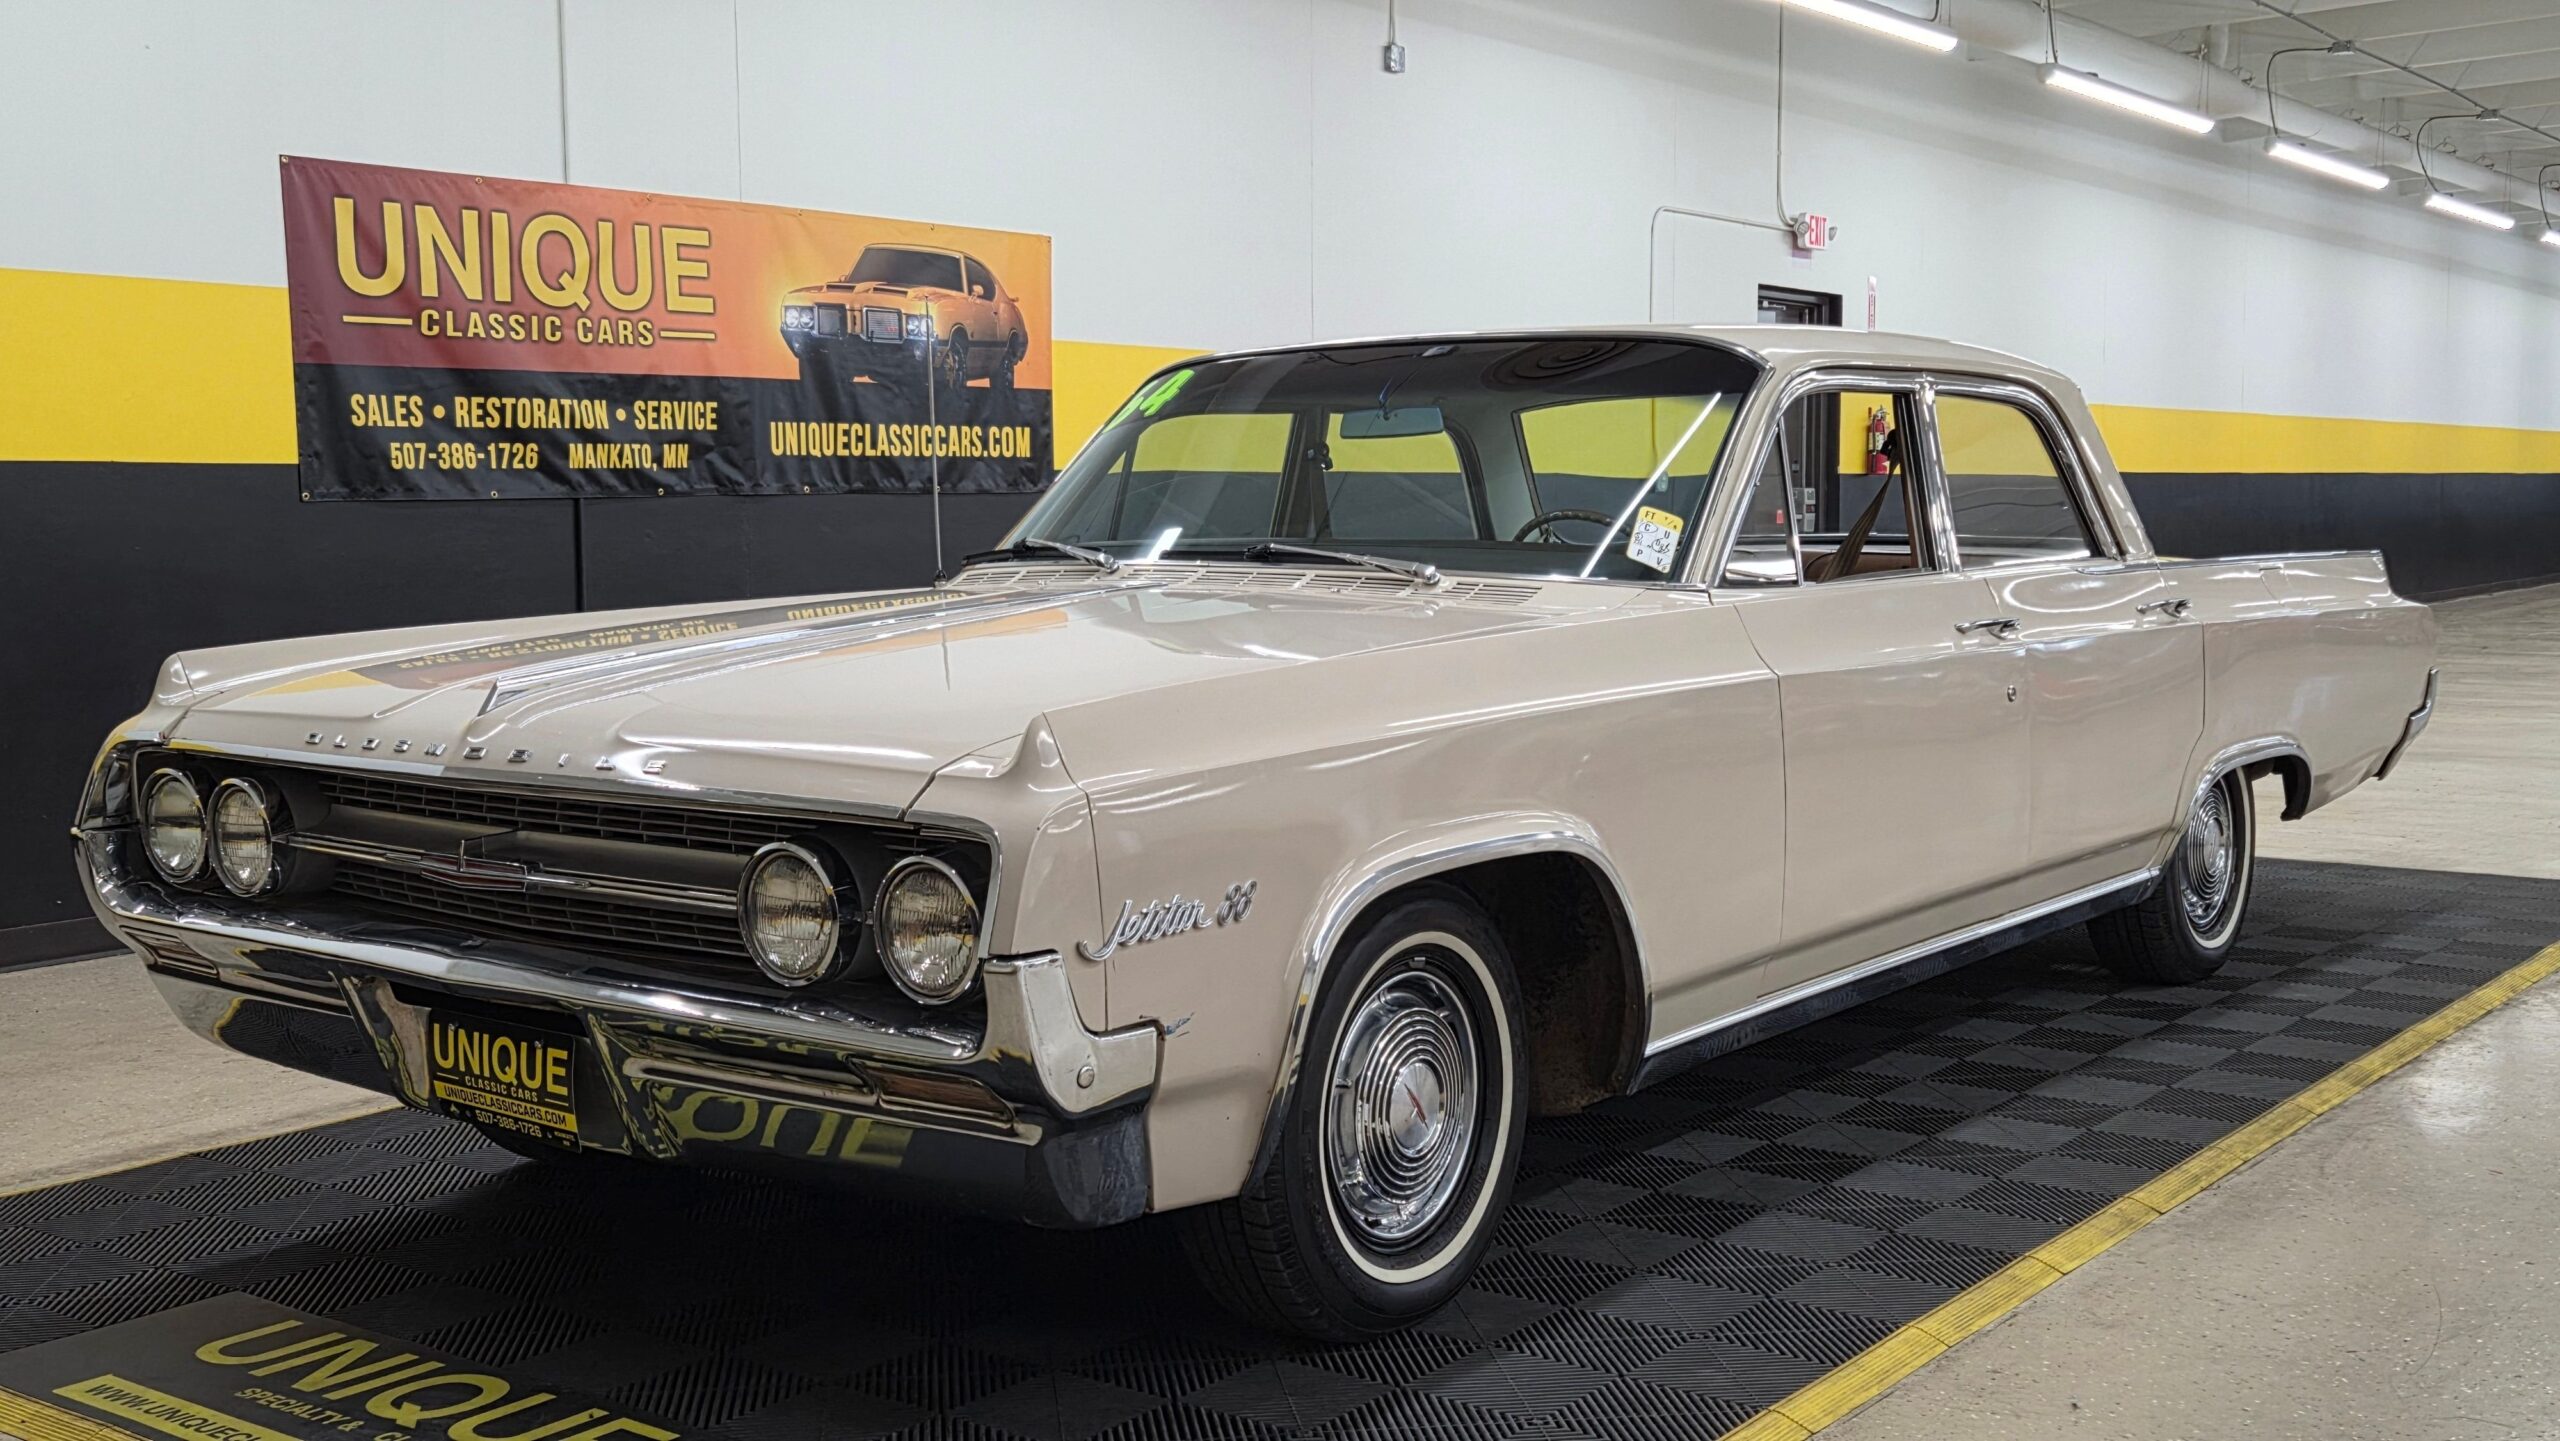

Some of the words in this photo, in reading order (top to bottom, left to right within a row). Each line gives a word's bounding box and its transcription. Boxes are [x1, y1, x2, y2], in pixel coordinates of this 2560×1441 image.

[1809, 215, 1827, 247] EXIT
[333, 196, 716, 312] UNIQUE
[420, 309, 563, 342] CLASSIC
[577, 317, 655, 346] CARS
[350, 393, 424, 428] SALES
[454, 396, 609, 431] RESTORATION
[633, 400, 718, 431] SERVICE
[389, 442, 539, 470] 507-386-1726
[568, 442, 657, 472] MANKATO,
[662, 444, 690, 469] MN
[769, 421, 1031, 459] UNIQUECLASSICCARS.COM
[1645, 510, 1656, 520] FT
[1077, 894, 1213, 961] Jetstar
[1216, 880, 1257, 927] 88
[432, 1022, 568, 1097] UNIQUE
[444, 1085, 567, 1127] UNIQUECLASSICCARS.COM
[465, 1075, 507, 1095] CLASSIC
[511, 1086, 538, 1103] CARS
[475, 1110, 542, 1138] 507-386-1726
[234, 1387, 351, 1425] SPECIALTY
[337, 1420, 365, 1432] &
